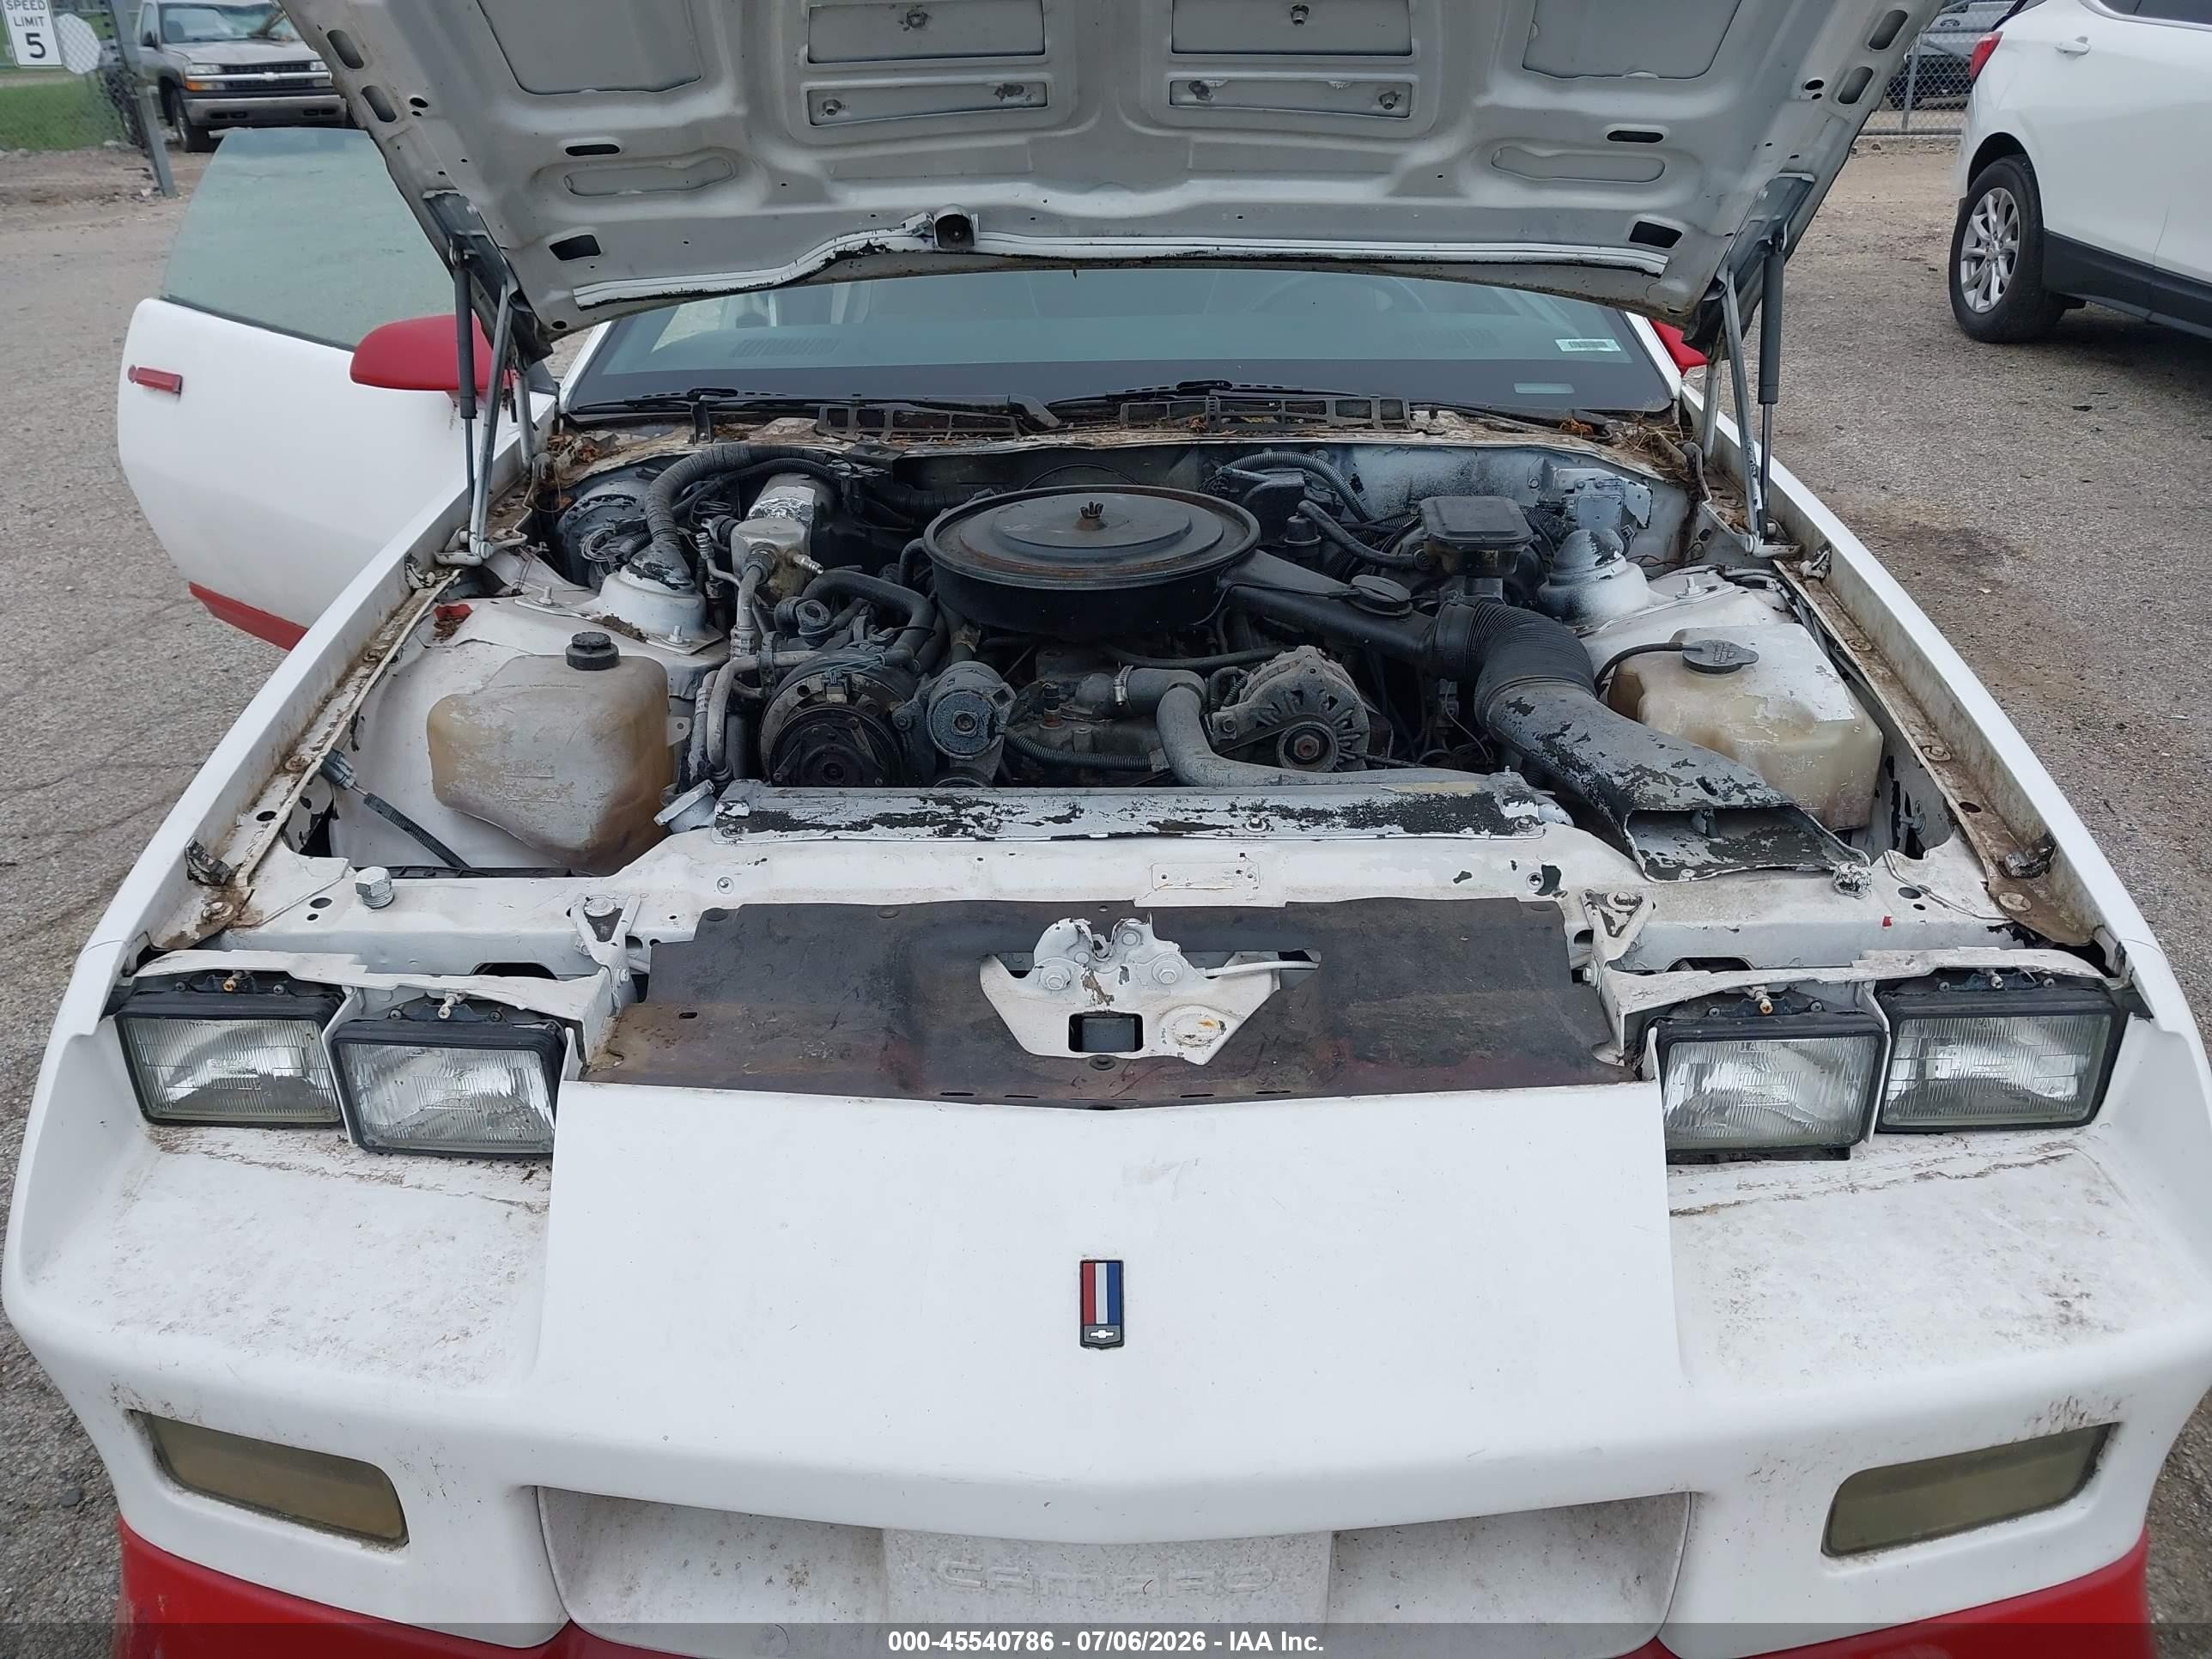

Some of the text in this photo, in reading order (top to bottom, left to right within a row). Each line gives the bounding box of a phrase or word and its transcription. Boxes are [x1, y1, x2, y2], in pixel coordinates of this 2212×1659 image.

[6, 0, 46, 10] SPEED
[13, 16, 45, 27] LIMIT
[25, 33, 46, 59] 5
